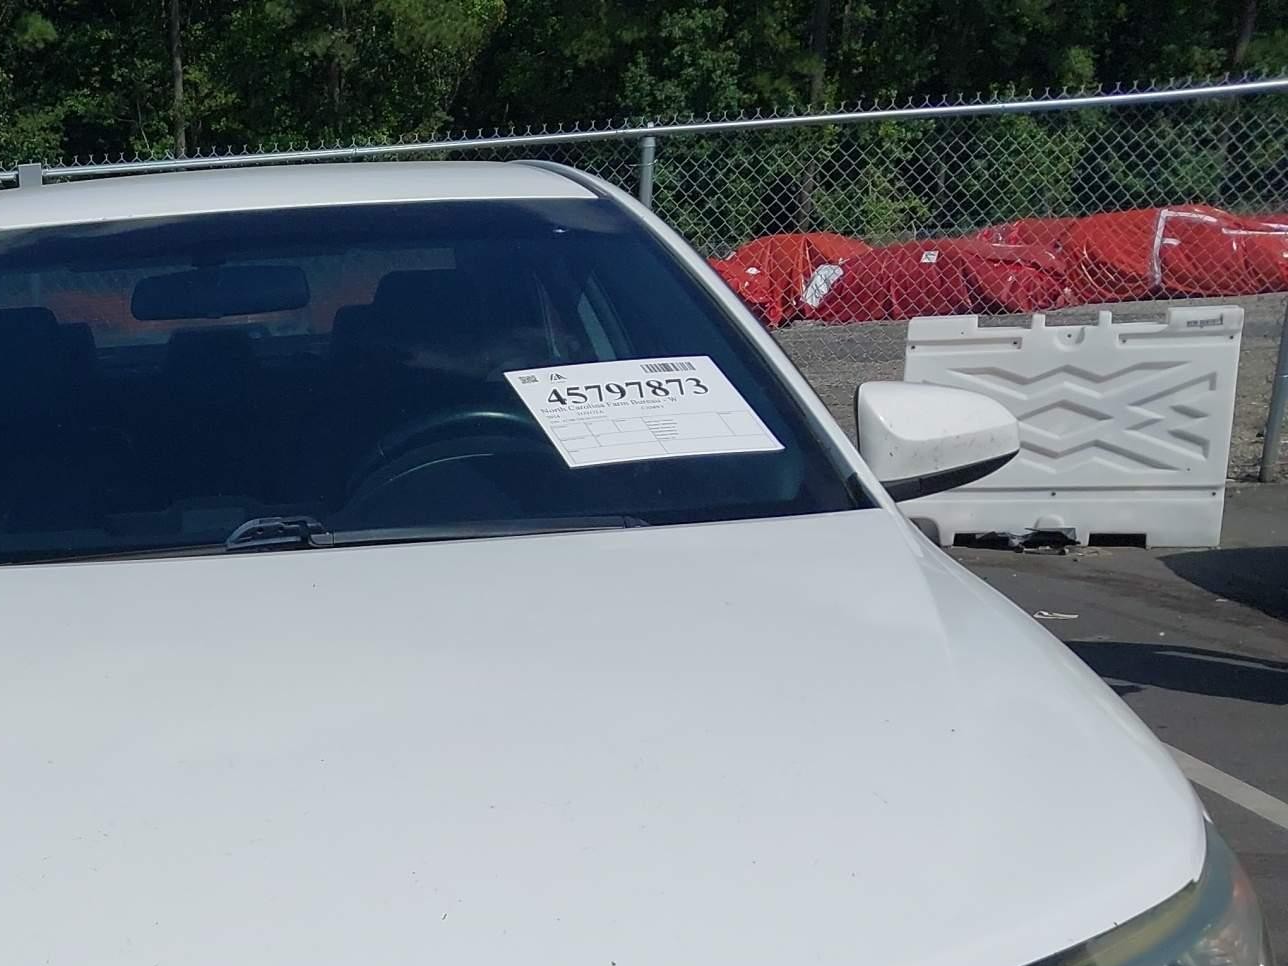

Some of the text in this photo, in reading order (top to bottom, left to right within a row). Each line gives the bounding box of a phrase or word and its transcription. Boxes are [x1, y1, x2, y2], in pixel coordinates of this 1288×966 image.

[547, 377, 709, 405] 45797873
[541, 405, 567, 414] North
[568, 402, 605, 411] Carolina
